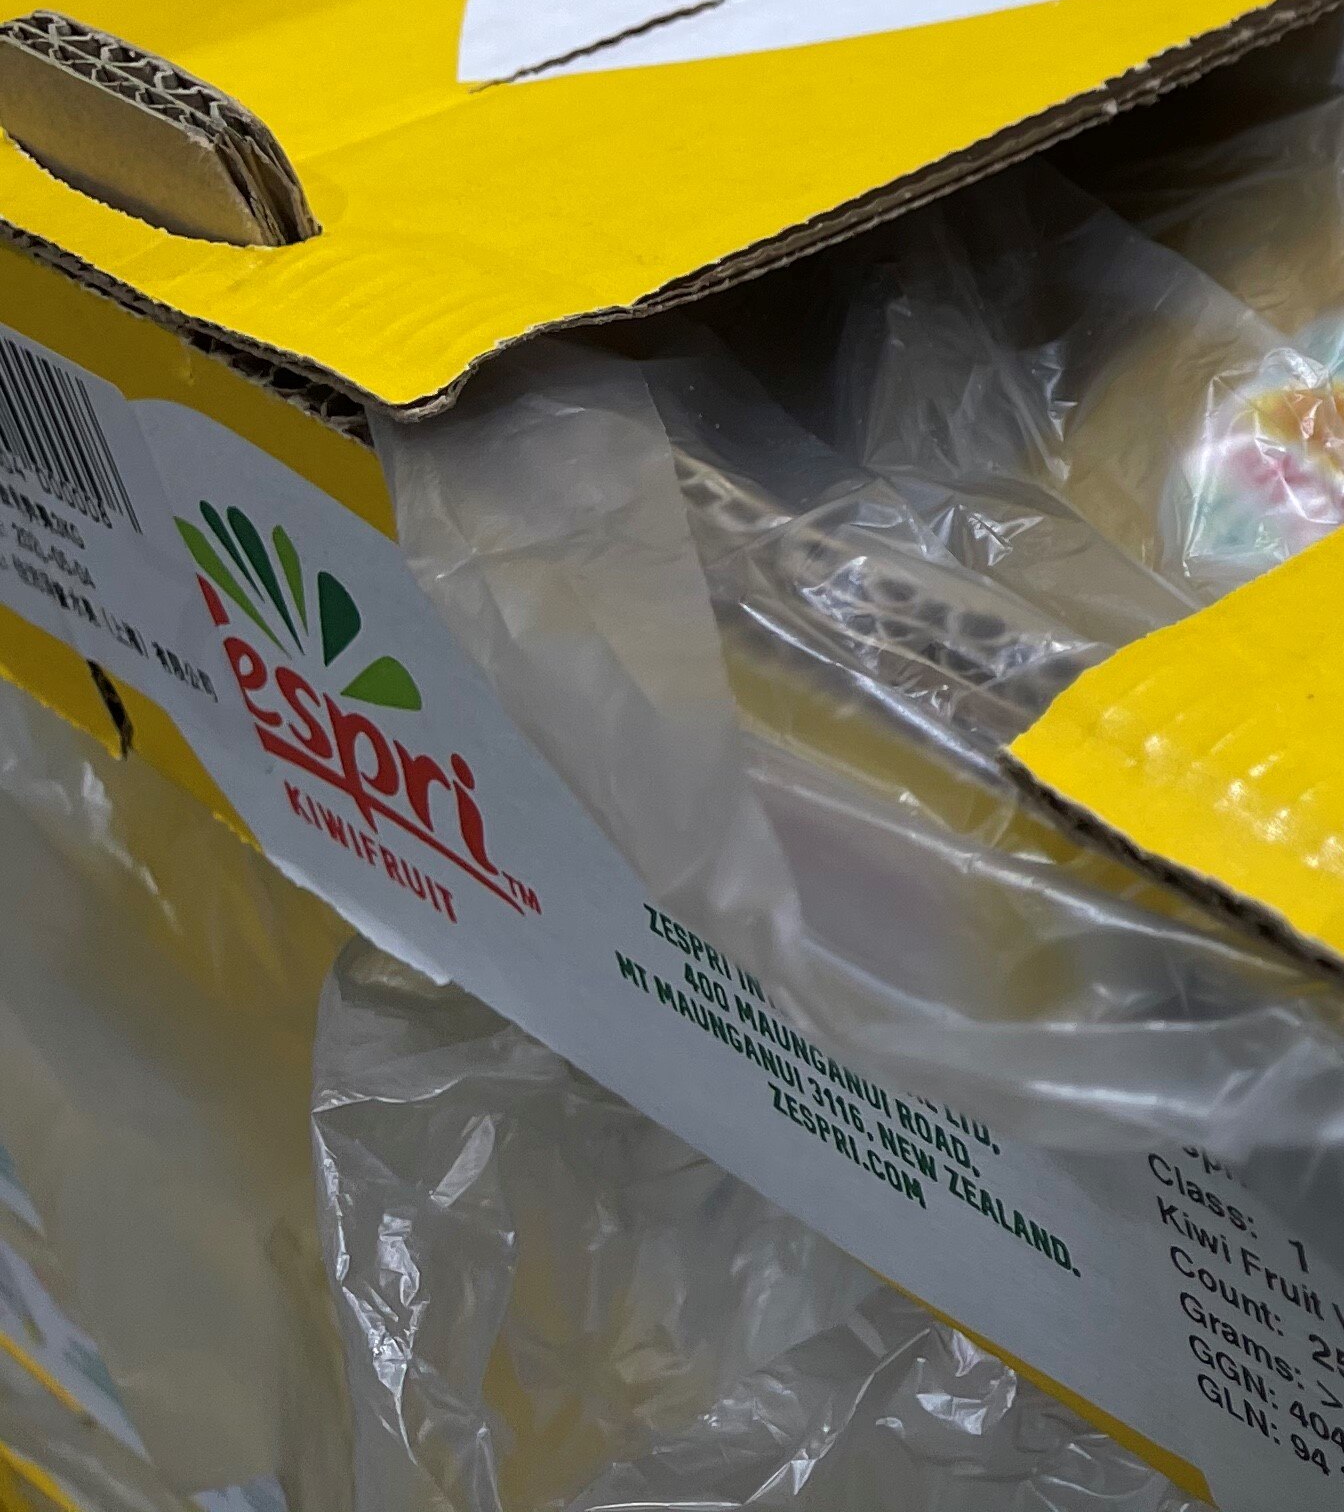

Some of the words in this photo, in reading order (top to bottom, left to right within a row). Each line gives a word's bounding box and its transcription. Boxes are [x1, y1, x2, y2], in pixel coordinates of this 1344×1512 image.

[284, 778, 457, 925] KIWIFRUIT
[643, 902, 733, 982] ZESPRI
[684, 961, 730, 1013] 400
[733, 993, 892, 1120] MAUNGANUI
[615, 949, 650, 994] MT
[653, 975, 805, 1095] MAUNGANUI
[876, 1121, 938, 1182] NEW
[944, 1164, 1082, 1278] ZEALAND.
[768, 1080, 927, 1210] ZESPRI.COM
[1147, 1152, 1258, 1239] Class:
[1287, 1239, 1310, 1275] 1
[1156, 1195, 1232, 1265] Kiwi
[1240, 1246, 1325, 1322] Fruit
[1169, 1245, 1284, 1337] Count:
[1179, 1291, 1305, 1390] Grams:
[1188, 1334, 1279, 1410] GGN:
[1197, 1372, 1281, 1446] GLN:
[1290, 1433, 1331, 1477] 94
